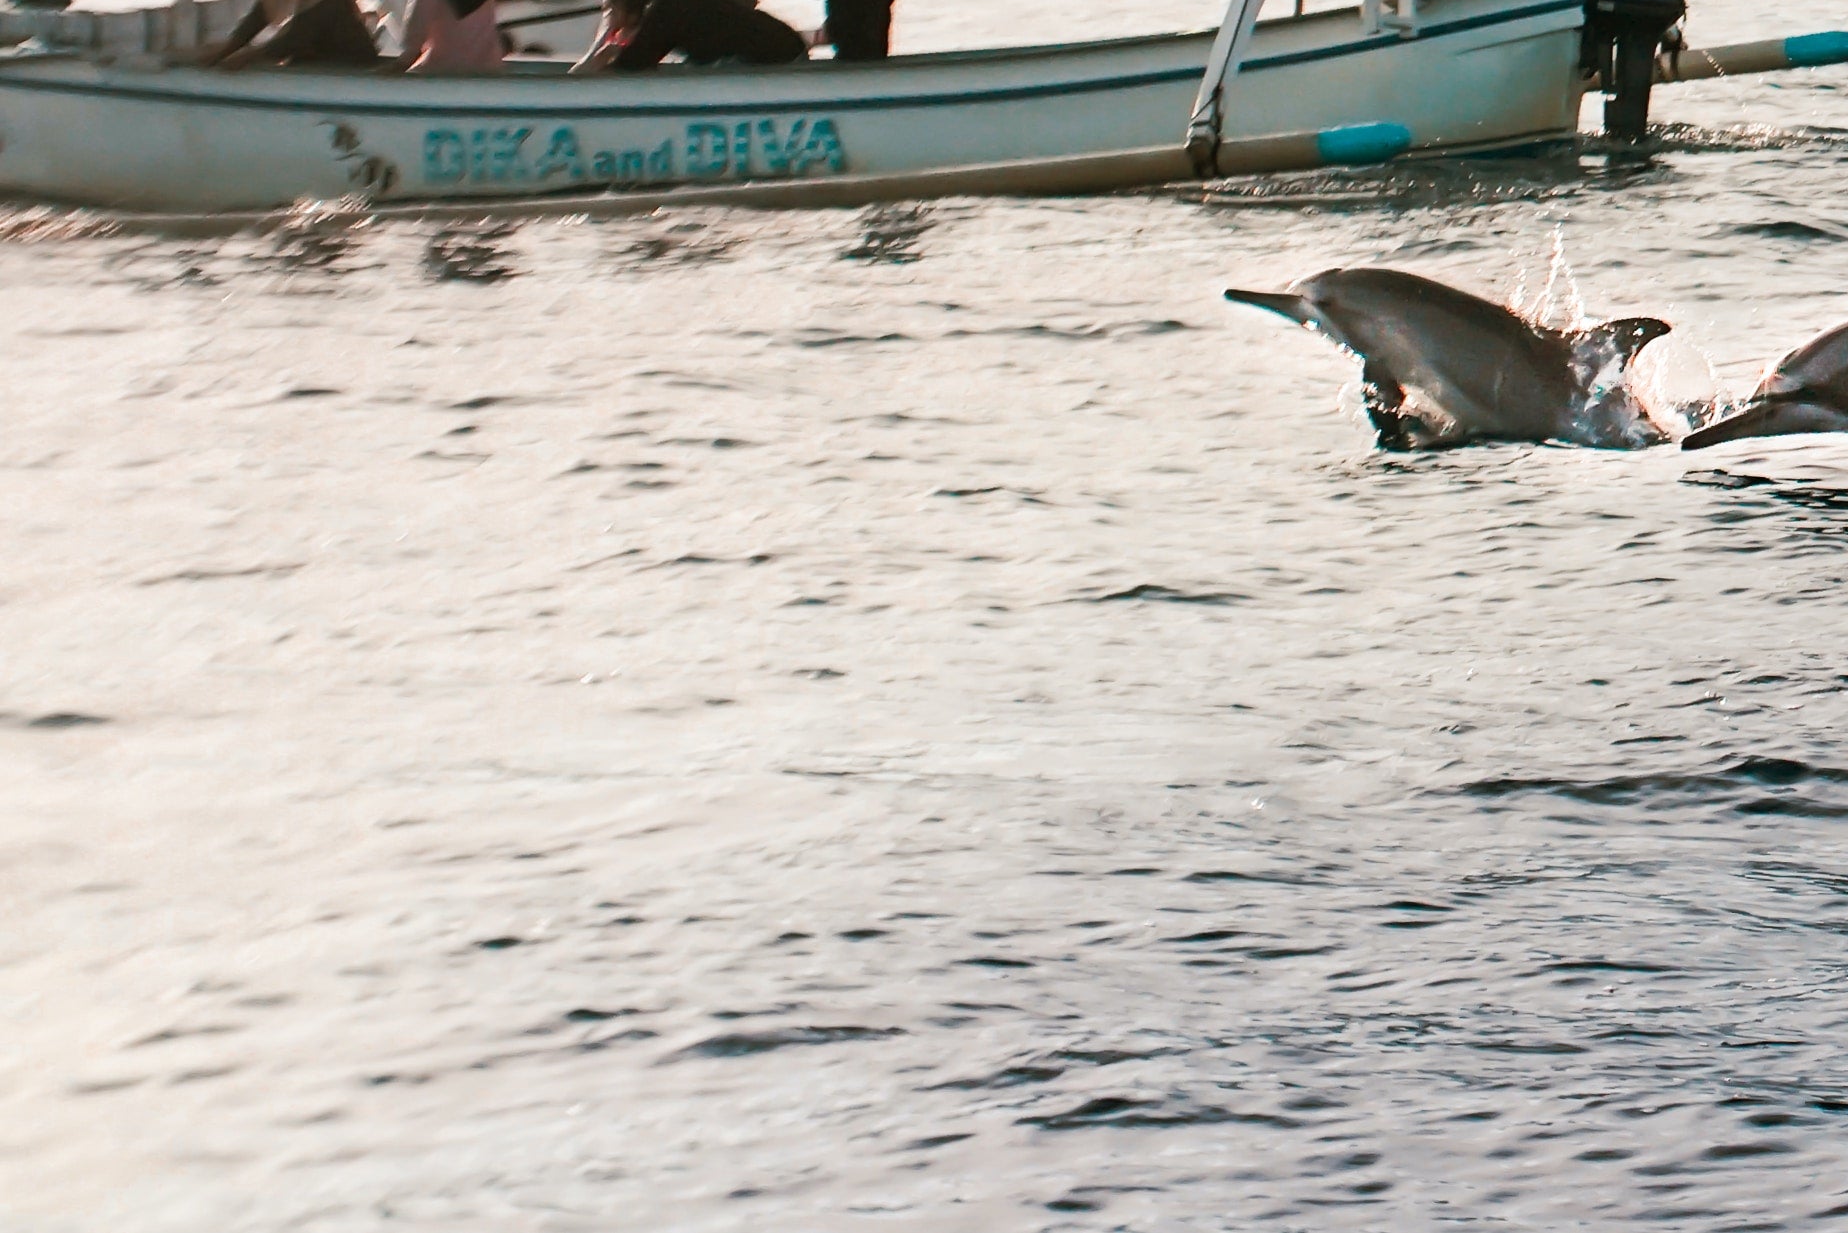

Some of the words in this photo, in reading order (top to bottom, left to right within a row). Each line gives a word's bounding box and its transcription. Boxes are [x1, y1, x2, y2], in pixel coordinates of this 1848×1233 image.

[424, 126, 586, 183] DIKA
[592, 139, 673, 180] and
[685, 118, 846, 175] DIVA
